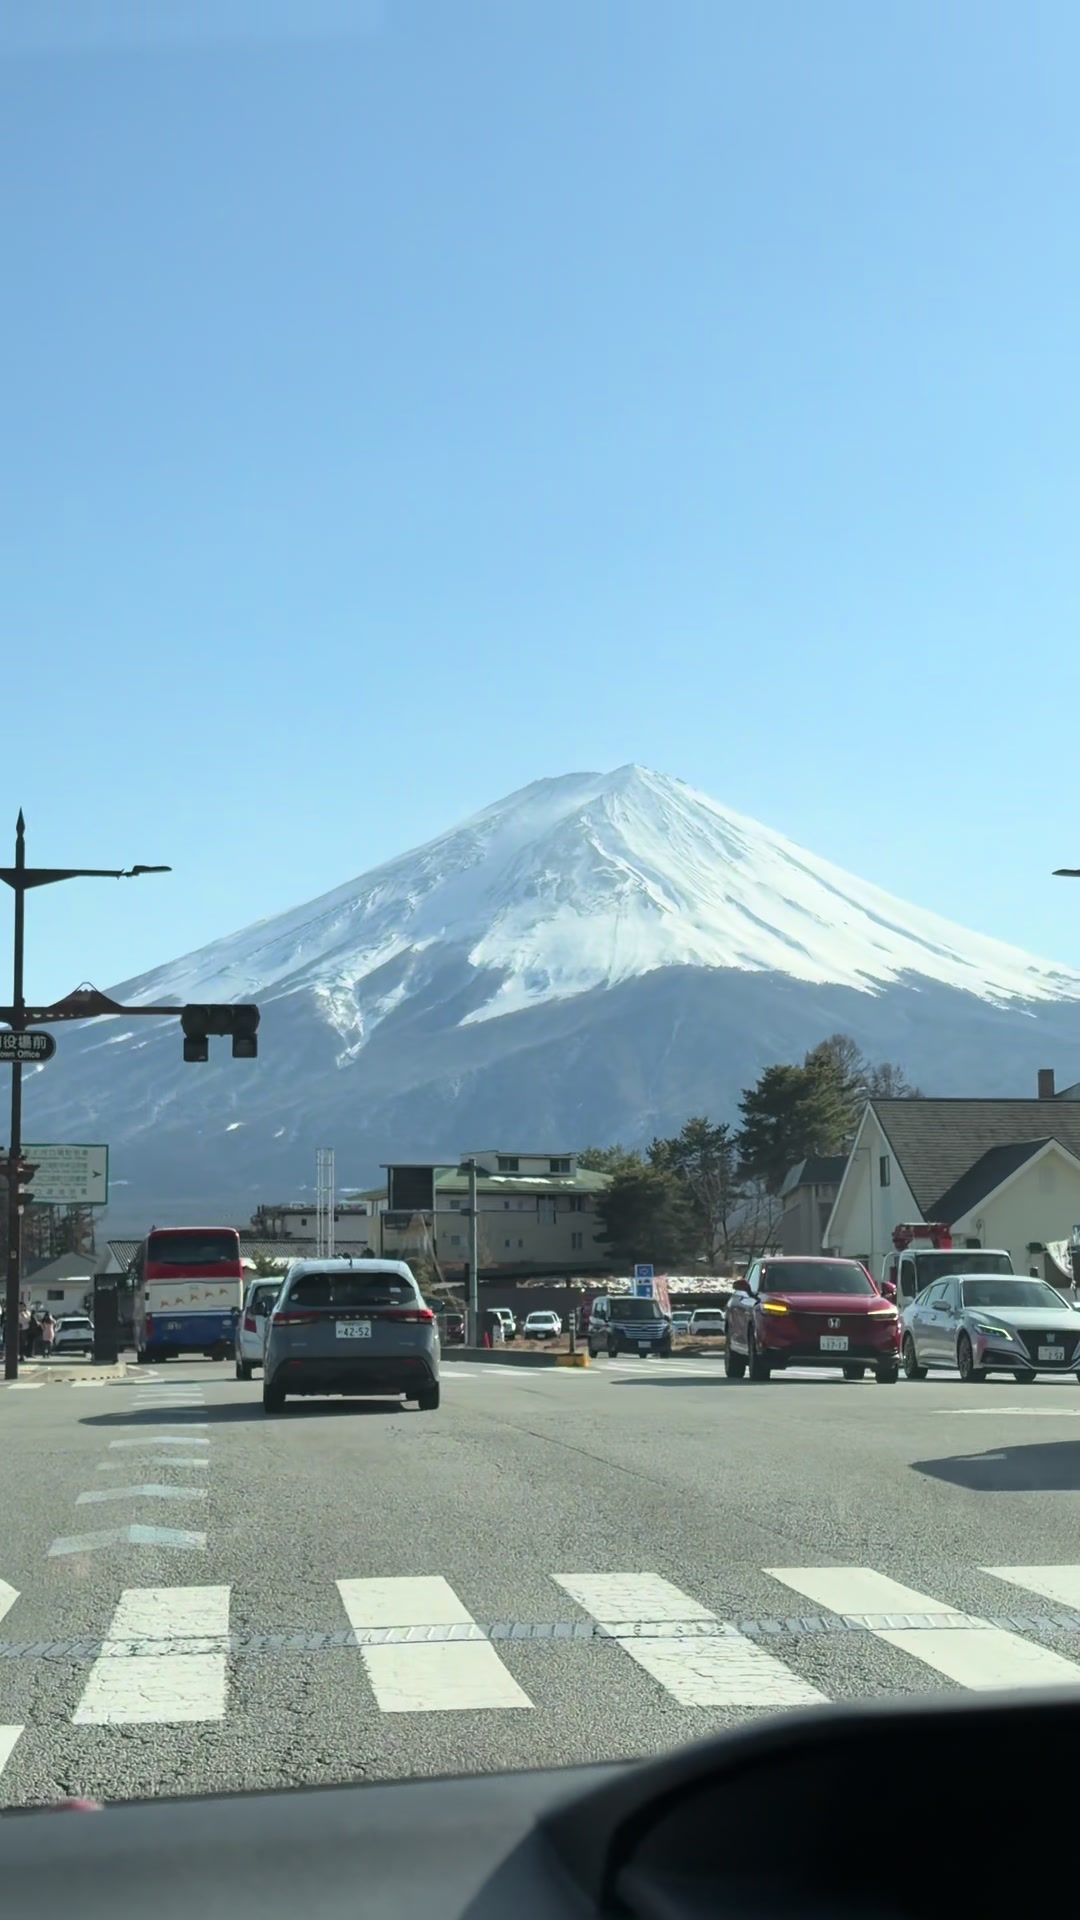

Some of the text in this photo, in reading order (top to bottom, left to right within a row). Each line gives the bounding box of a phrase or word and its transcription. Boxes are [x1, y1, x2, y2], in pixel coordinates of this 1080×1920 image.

[0, 1034, 47, 1050] 役場前
[17, 1050, 41, 1058] Office
[344, 1327, 370, 1337] 42-52
